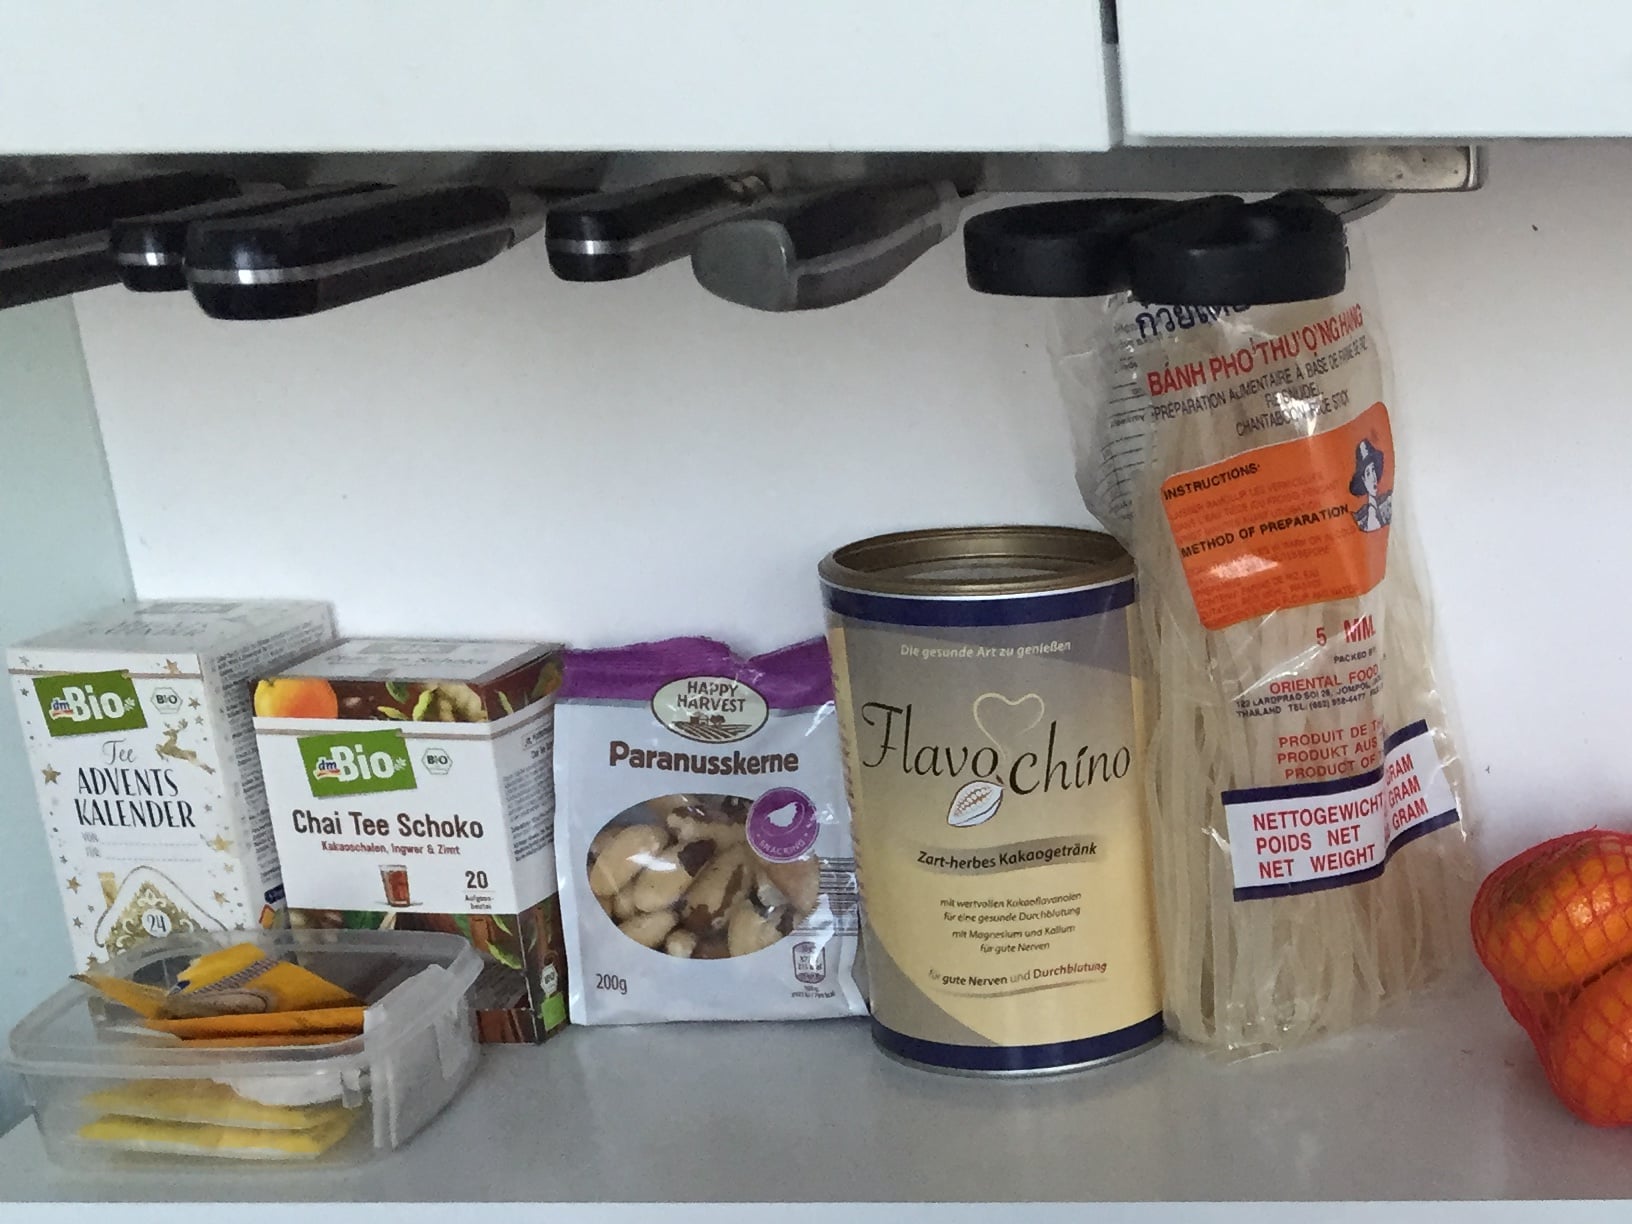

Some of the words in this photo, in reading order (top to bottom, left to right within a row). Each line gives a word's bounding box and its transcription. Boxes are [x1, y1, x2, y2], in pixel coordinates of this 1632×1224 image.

[1181, 532, 1235, 558] METHOD
[1239, 526, 1256, 541] OF
[1260, 504, 1350, 536] PREPARATION
[900, 644, 919, 657] Die
[922, 645, 973, 660] gesunde
[976, 646, 996, 658] Art
[1000, 647, 1013, 657] zu
[1017, 640, 1072, 658] genießen
[1316, 627, 1327, 647] 5
[688, 681, 739, 697] HAPPY
[1270, 674, 1343, 695] ORIENTAL
[62, 684, 125, 722] Bio
[677, 695, 746, 713] HARVEST
[1278, 729, 1344, 749] PRODUIT
[1351, 724, 1368, 739] DE
[102, 738, 137, 765] Tee
[330, 744, 395, 782] Bio
[609, 741, 800, 776] Paranusskerne
[1277, 745, 1349, 764] PRODUKT
[1355, 737, 1378, 754] AUS
[1285, 761, 1355, 780] PRODUCT
[1361, 753, 1377, 769] OF
[77, 767, 179, 797] ADVENTS
[74, 798, 197, 828] KALENDER
[1253, 792, 1385, 831] NETTOGEWICHT
[1388, 775, 1421, 808] GRAM
[292, 809, 342, 835] Chai
[348, 811, 390, 836] Tee
[397, 812, 484, 839] Schoko
[1256, 832, 1312, 855] POIDS
[1328, 825, 1361, 846] NET
[1391, 797, 1429, 831] GRAM
[391, 843, 423, 856] Ingwer
[437, 845, 461, 855] Zimt
[917, 850, 996, 869] Zart-herbes
[999, 842, 1098, 866] Kakaogetränk
[1259, 859, 1294, 879] NET
[1310, 844, 1376, 873] WEIGHT
[465, 870, 489, 889] 20
[940, 898, 955, 908] mit
[145, 914, 167, 933] 24
[944, 911, 956, 922] für
[978, 912, 1017, 924] gesunde
[952, 930, 967, 939] mit
[969, 930, 1023, 942] Magnesium
[1024, 928, 1043, 938] und
[980, 944, 994, 954] für
[994, 944, 1016, 955] gute
[1017, 942, 1050, 952] Nerven
[596, 973, 628, 995] 200g
[942, 974, 967, 986] gute
[968, 975, 1008, 987] Nerven
[1010, 971, 1031, 984] und
[1033, 961, 1108, 980] Durchblutung
